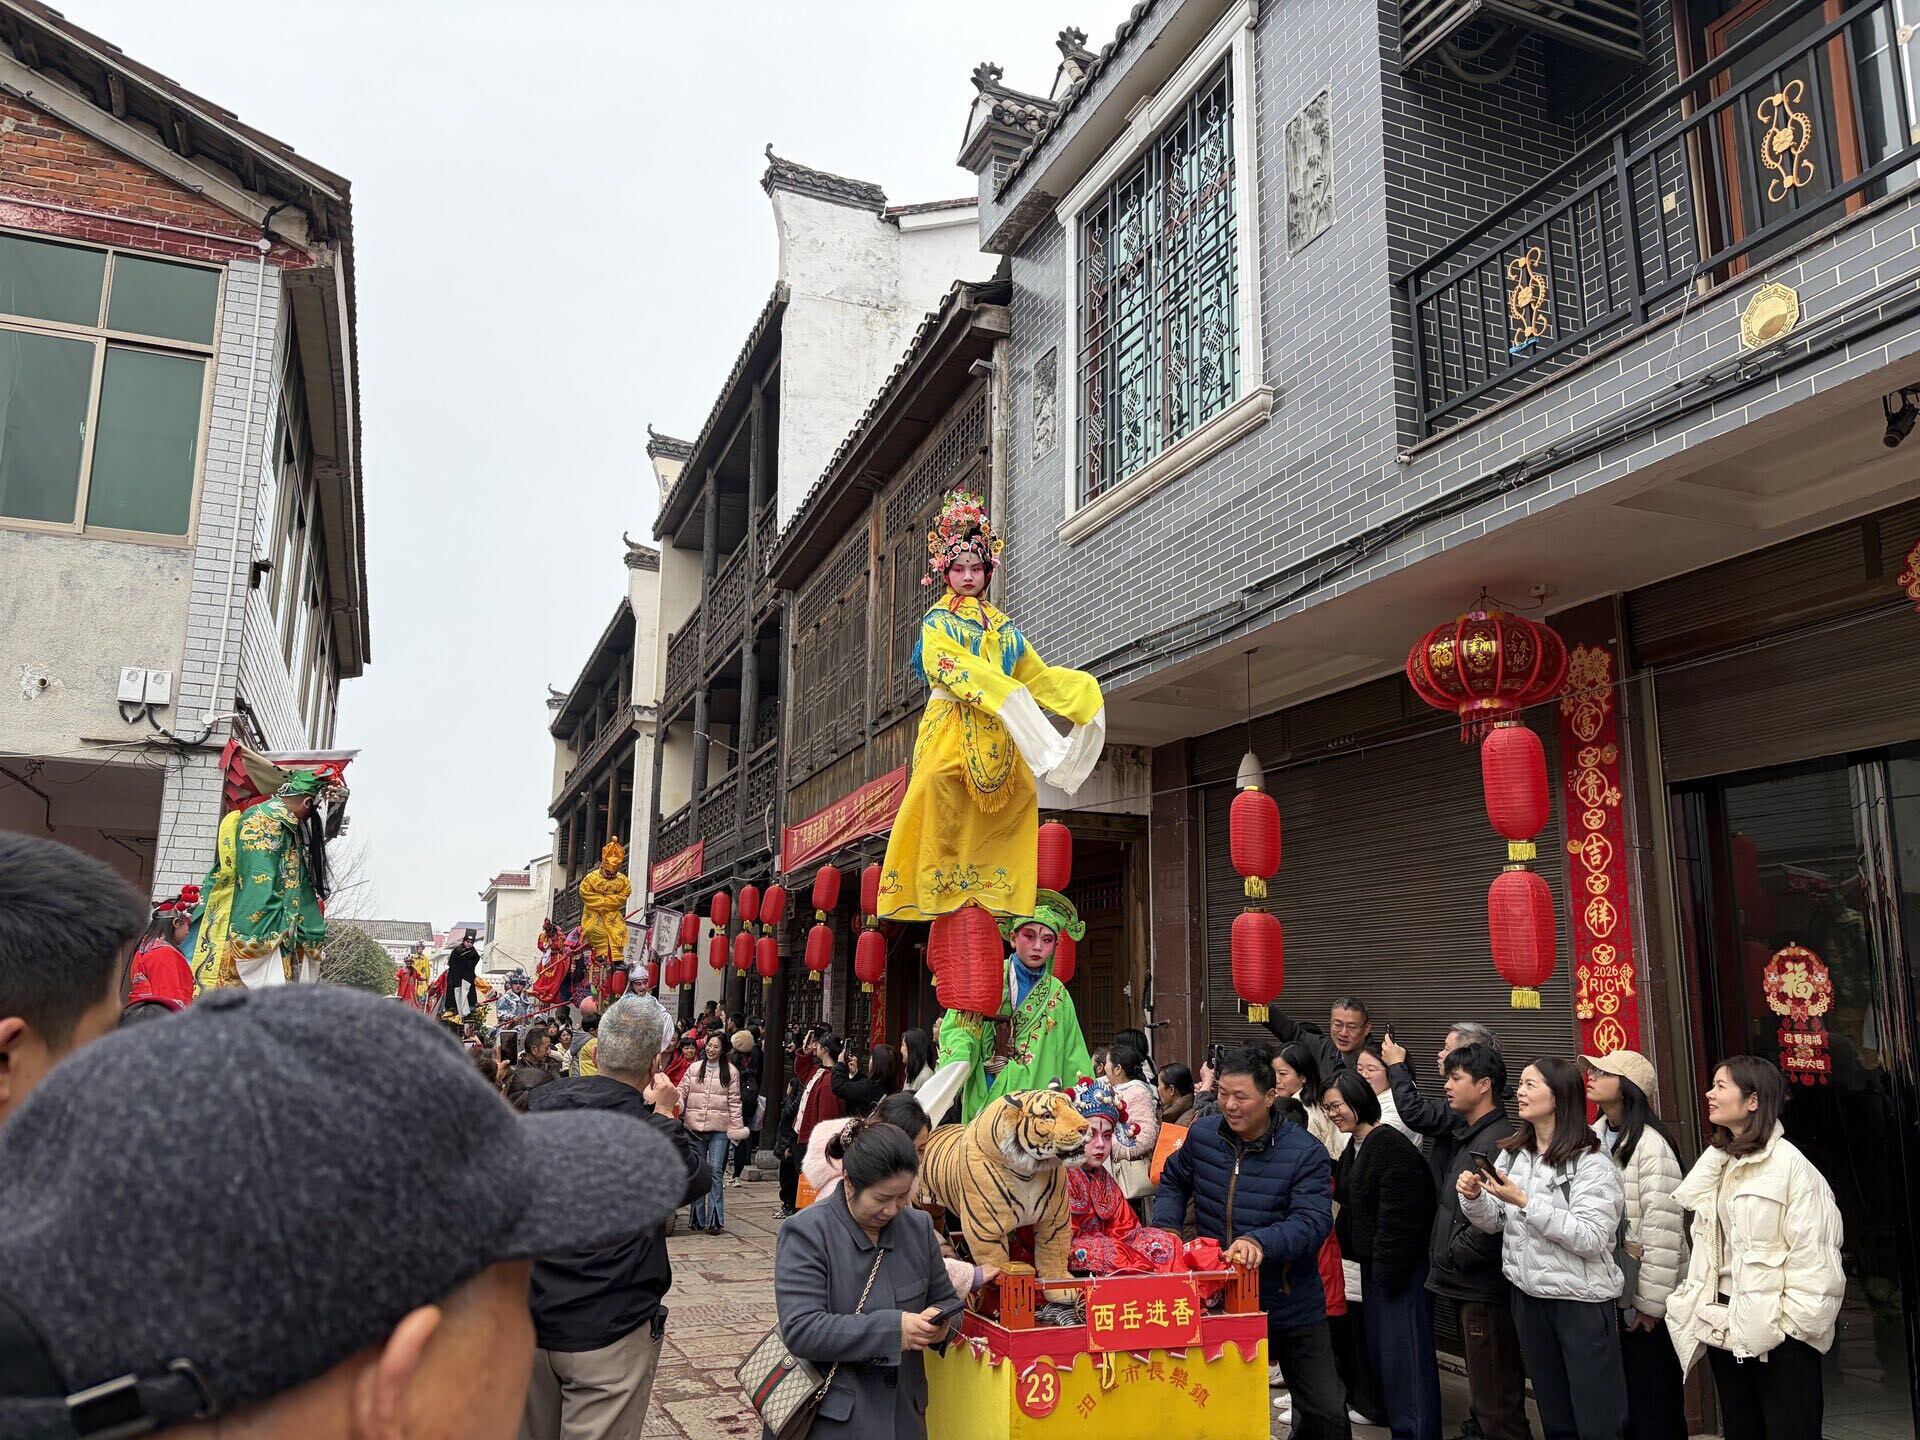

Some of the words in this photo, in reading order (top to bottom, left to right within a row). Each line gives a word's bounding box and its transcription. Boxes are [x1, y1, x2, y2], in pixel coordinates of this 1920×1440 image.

[1594, 965, 1619, 977] 2026
[1780, 962, 1815, 999] 福
[1589, 976, 1626, 993] RICH
[1786, 1057, 1825, 1070] 马年大吉
[1091, 1297, 1196, 1332] 西岳进香
[1026, 1373, 1055, 1404] 23
